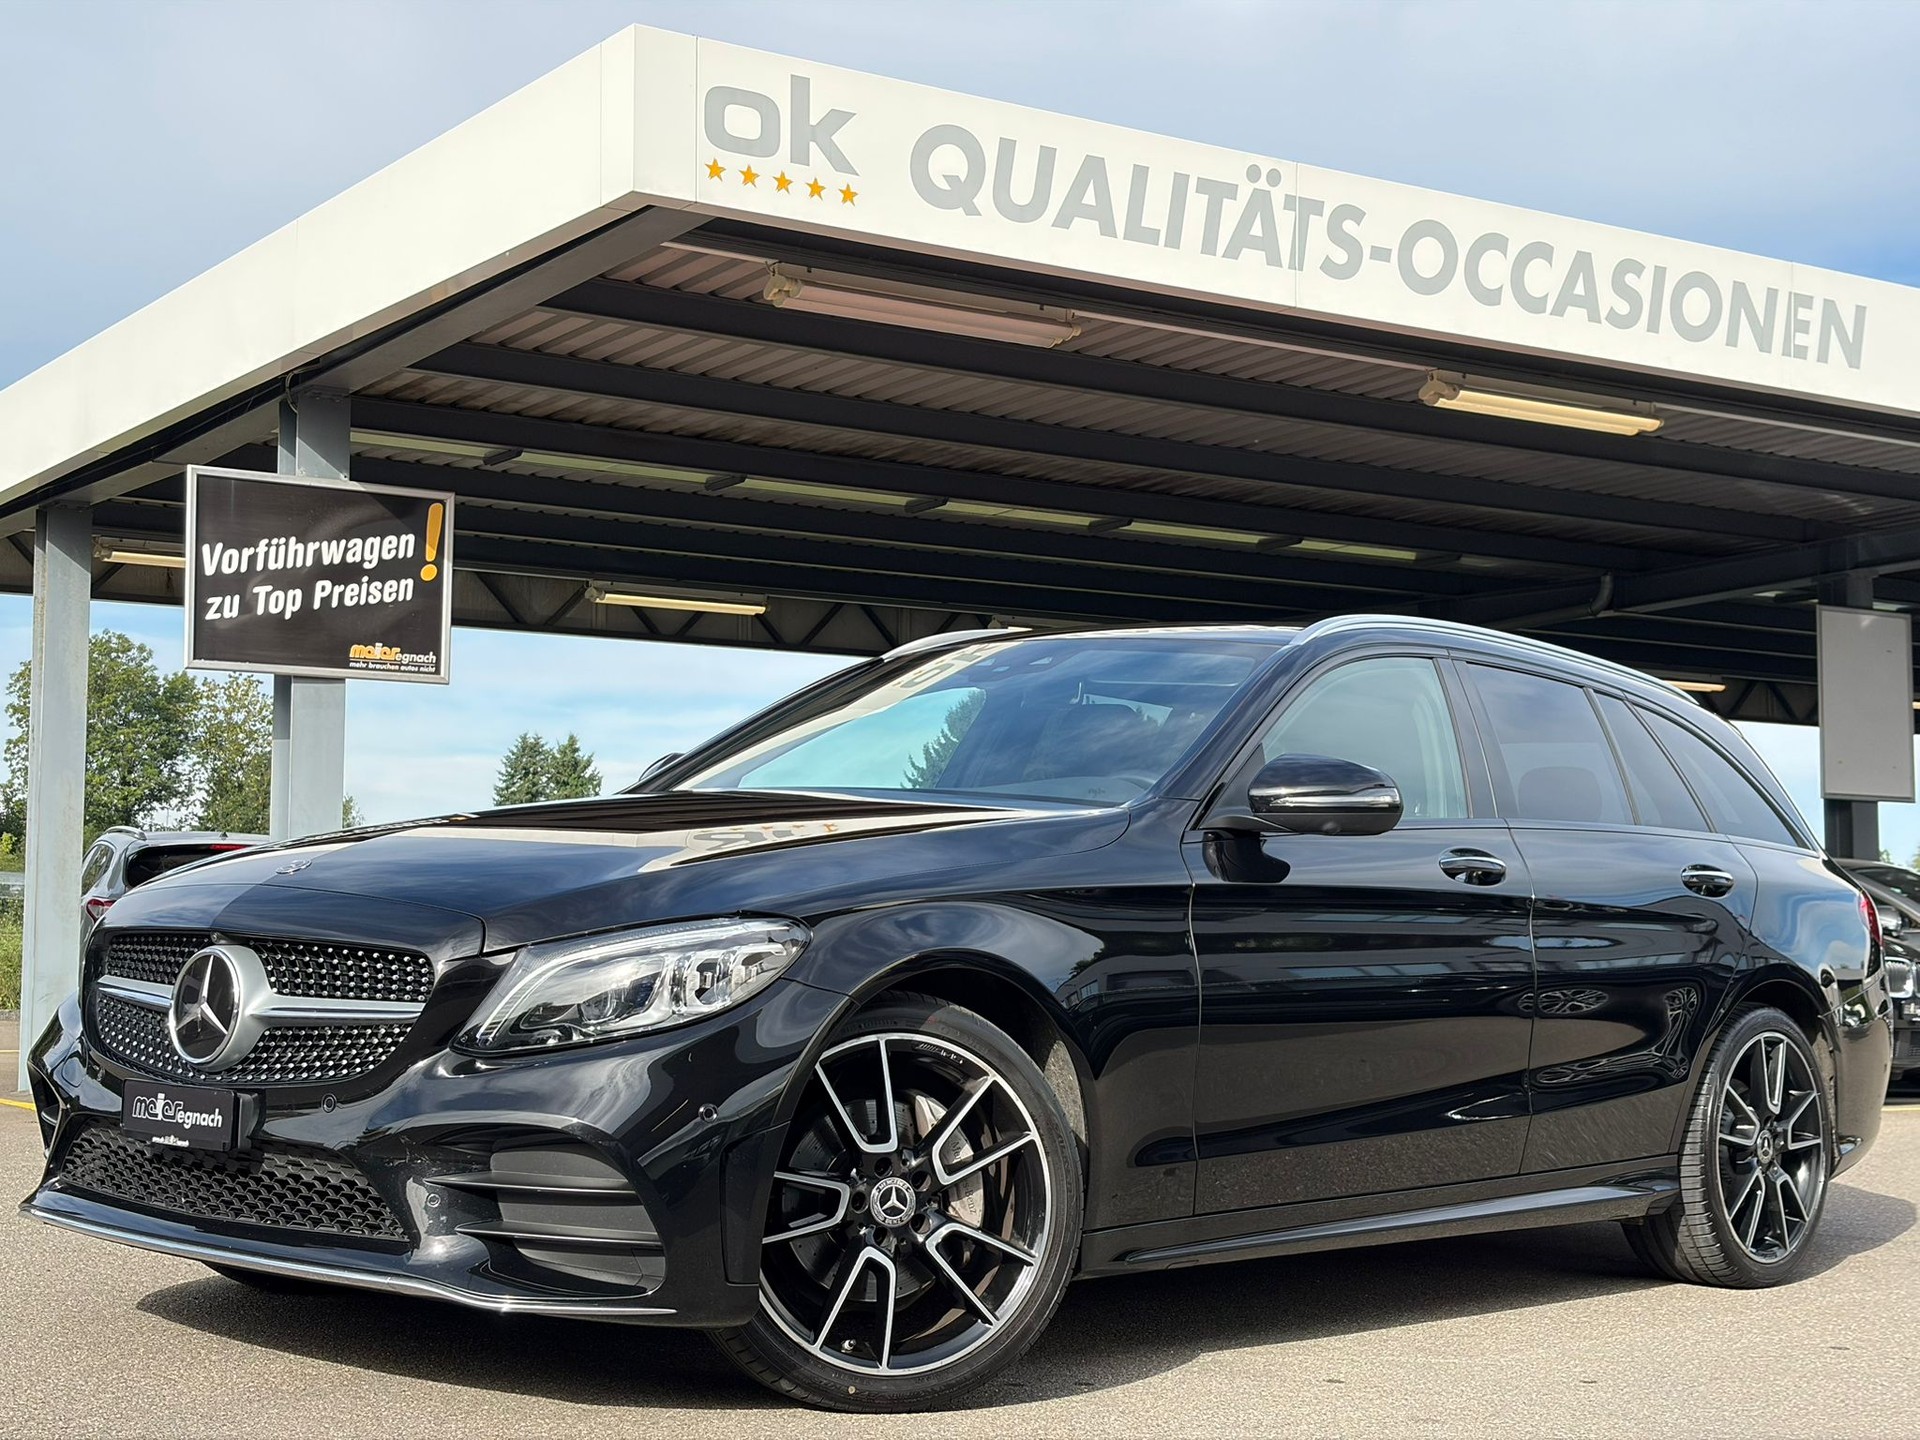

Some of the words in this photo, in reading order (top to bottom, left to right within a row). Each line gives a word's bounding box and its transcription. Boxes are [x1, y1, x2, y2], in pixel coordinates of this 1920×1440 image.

[703, 74, 860, 177] ok
[909, 123, 1868, 370] QUALITÄTS-OCCASIONEN
[201, 533, 416, 577] Vorführwagen
[204, 594, 240, 621] zu
[252, 585, 303, 621] Top
[312, 575, 415, 611] Preisen
